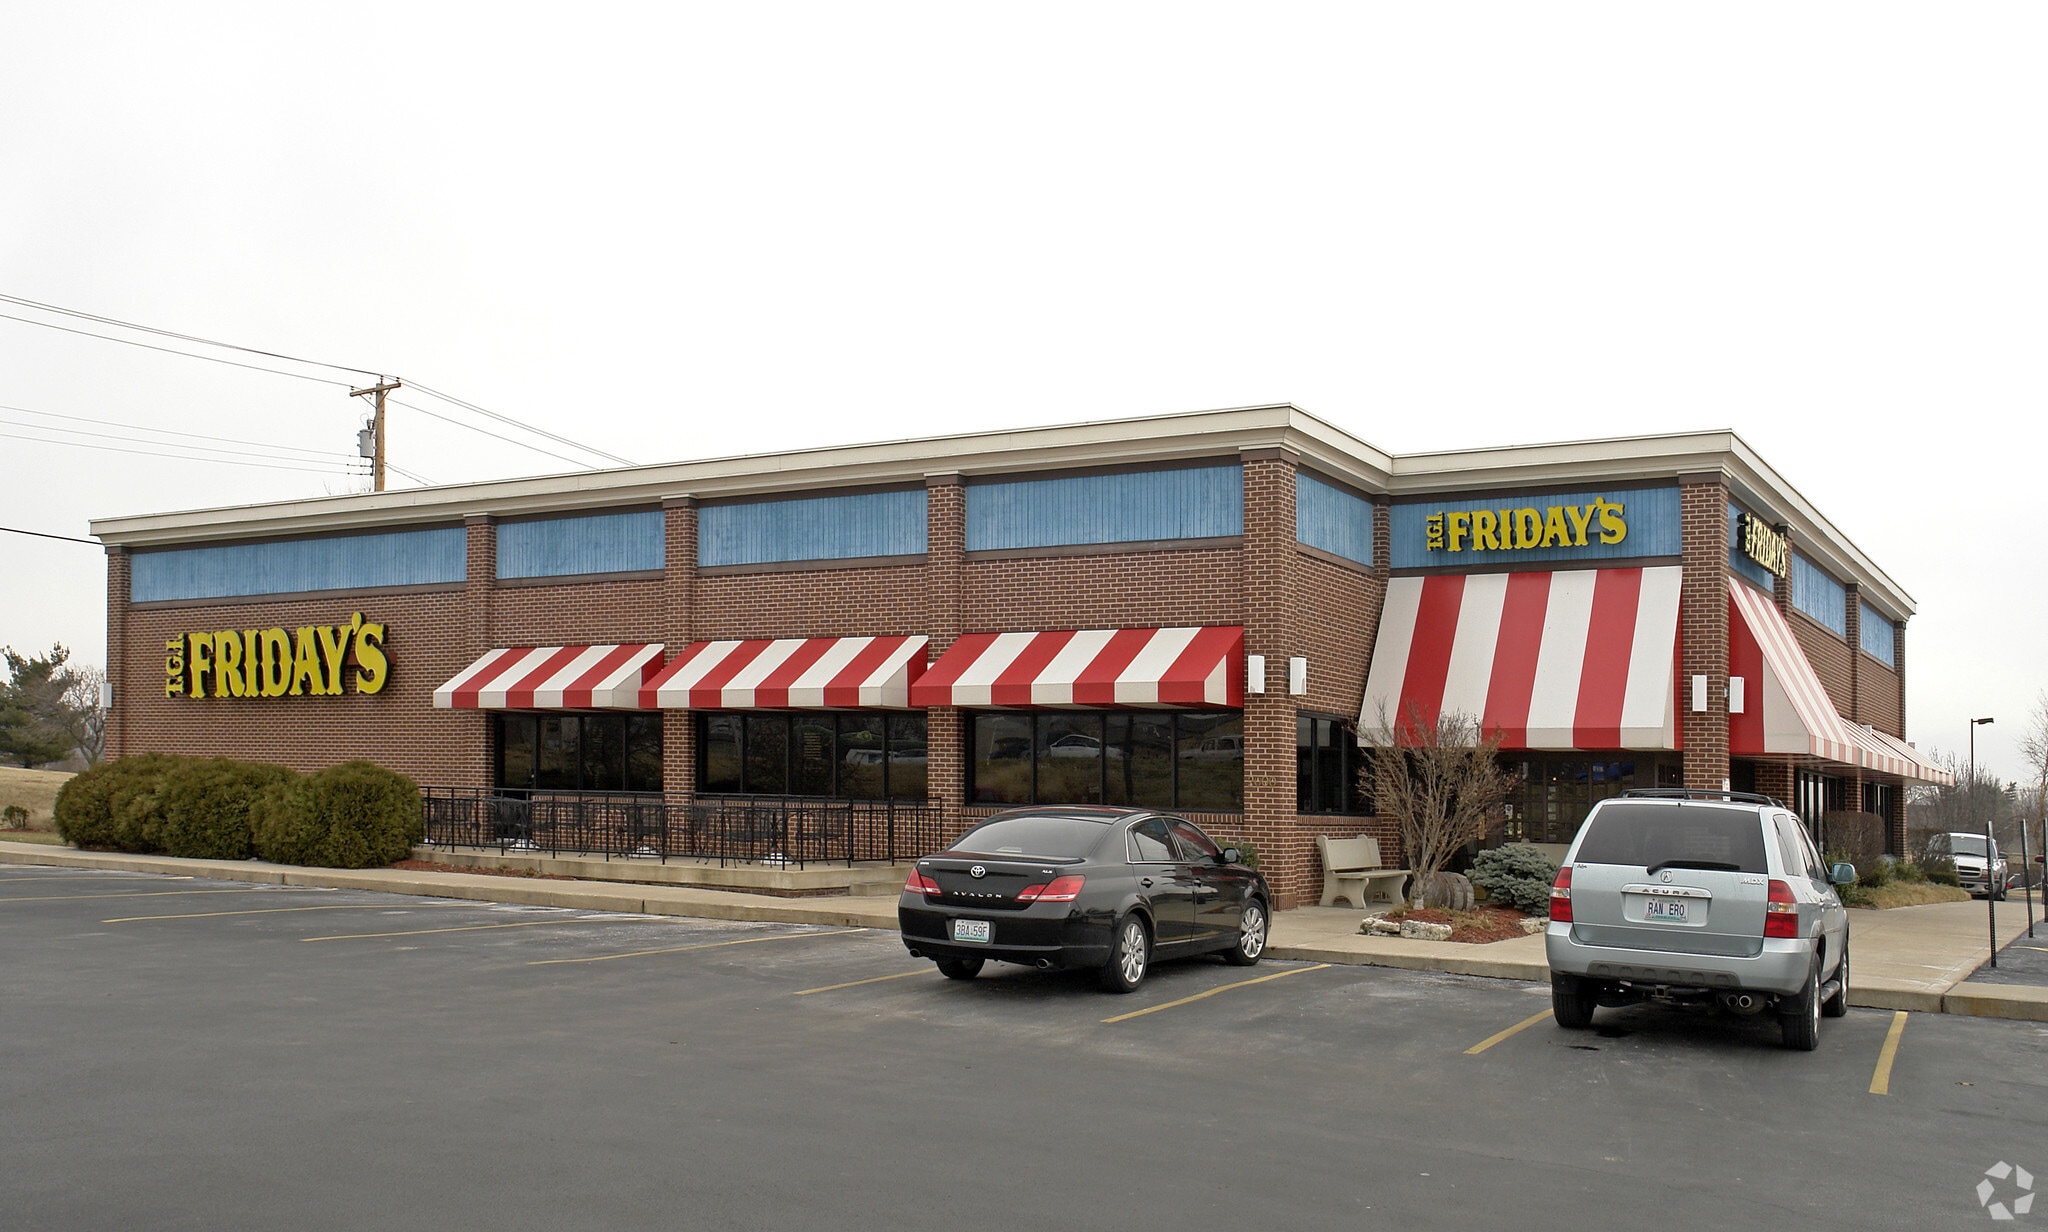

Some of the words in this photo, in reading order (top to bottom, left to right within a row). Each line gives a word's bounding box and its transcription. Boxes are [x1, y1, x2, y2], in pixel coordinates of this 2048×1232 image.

[1447, 496, 1628, 552] FRIDAY'S
[188, 611, 388, 699] FRIDAY'S
[1740, 877, 1764, 886] MDX
[1648, 902, 1664, 915] RAN
